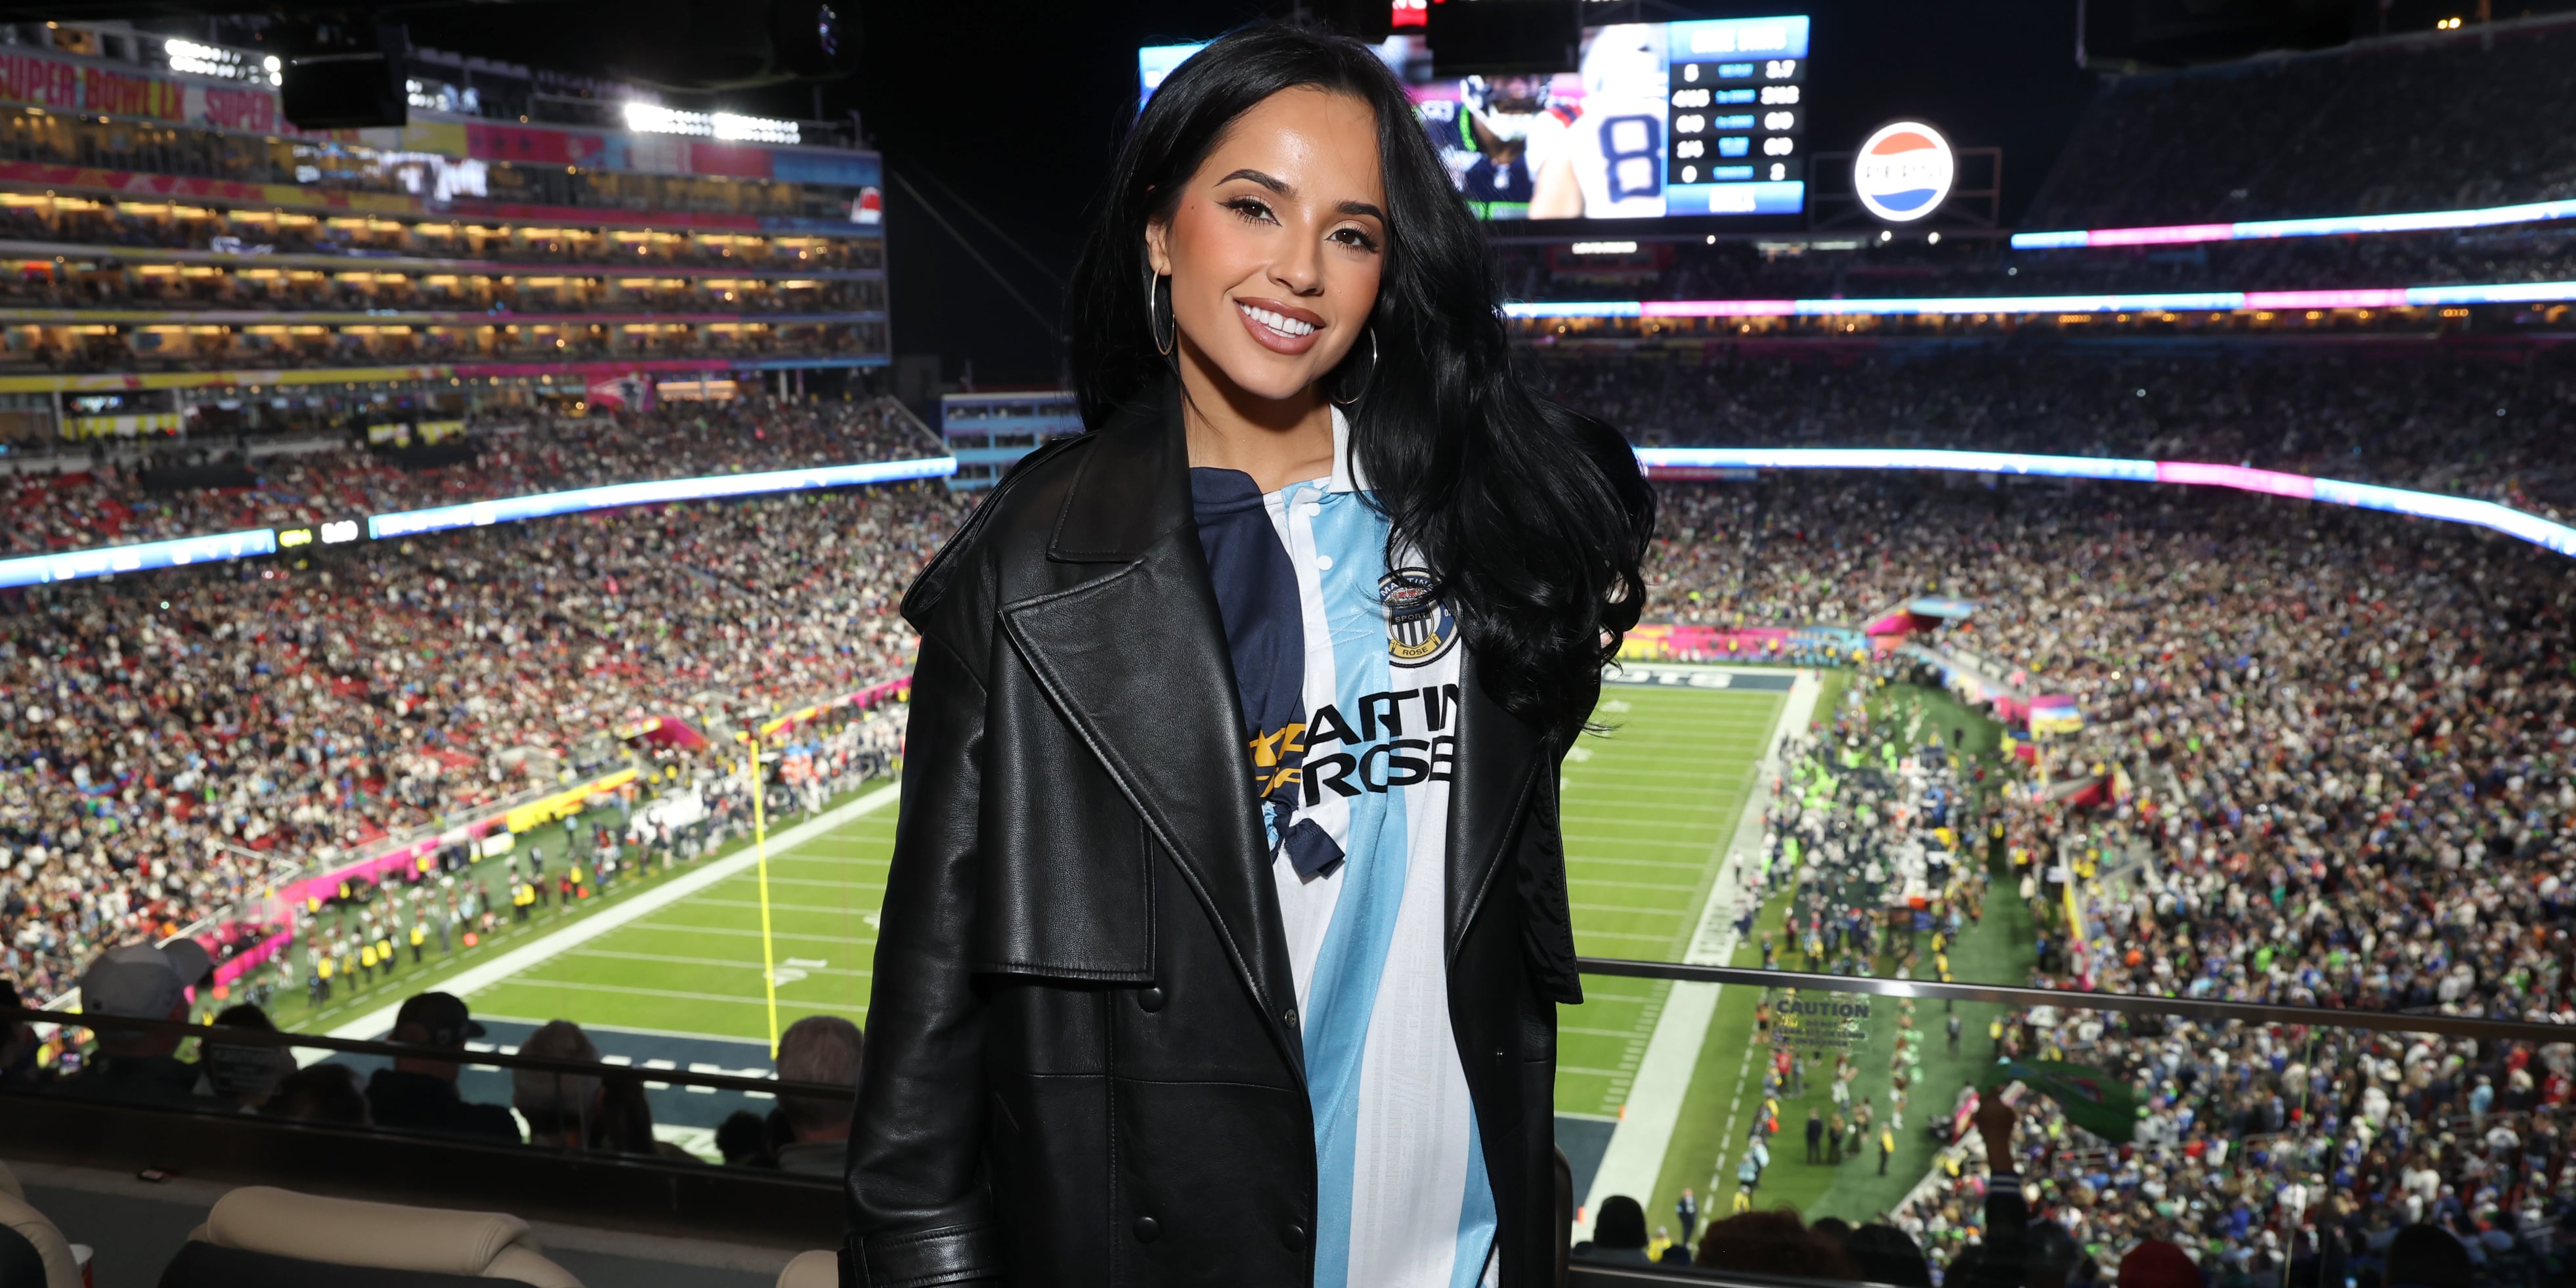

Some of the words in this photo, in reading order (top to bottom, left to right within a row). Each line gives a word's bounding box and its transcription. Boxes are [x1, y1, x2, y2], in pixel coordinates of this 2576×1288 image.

[1381, 578, 1434, 596] MATINE
[1395, 612, 1427, 623] SPORT
[1402, 646, 1428, 656] ROSE
[1777, 1000, 1869, 1018] CAUTION
